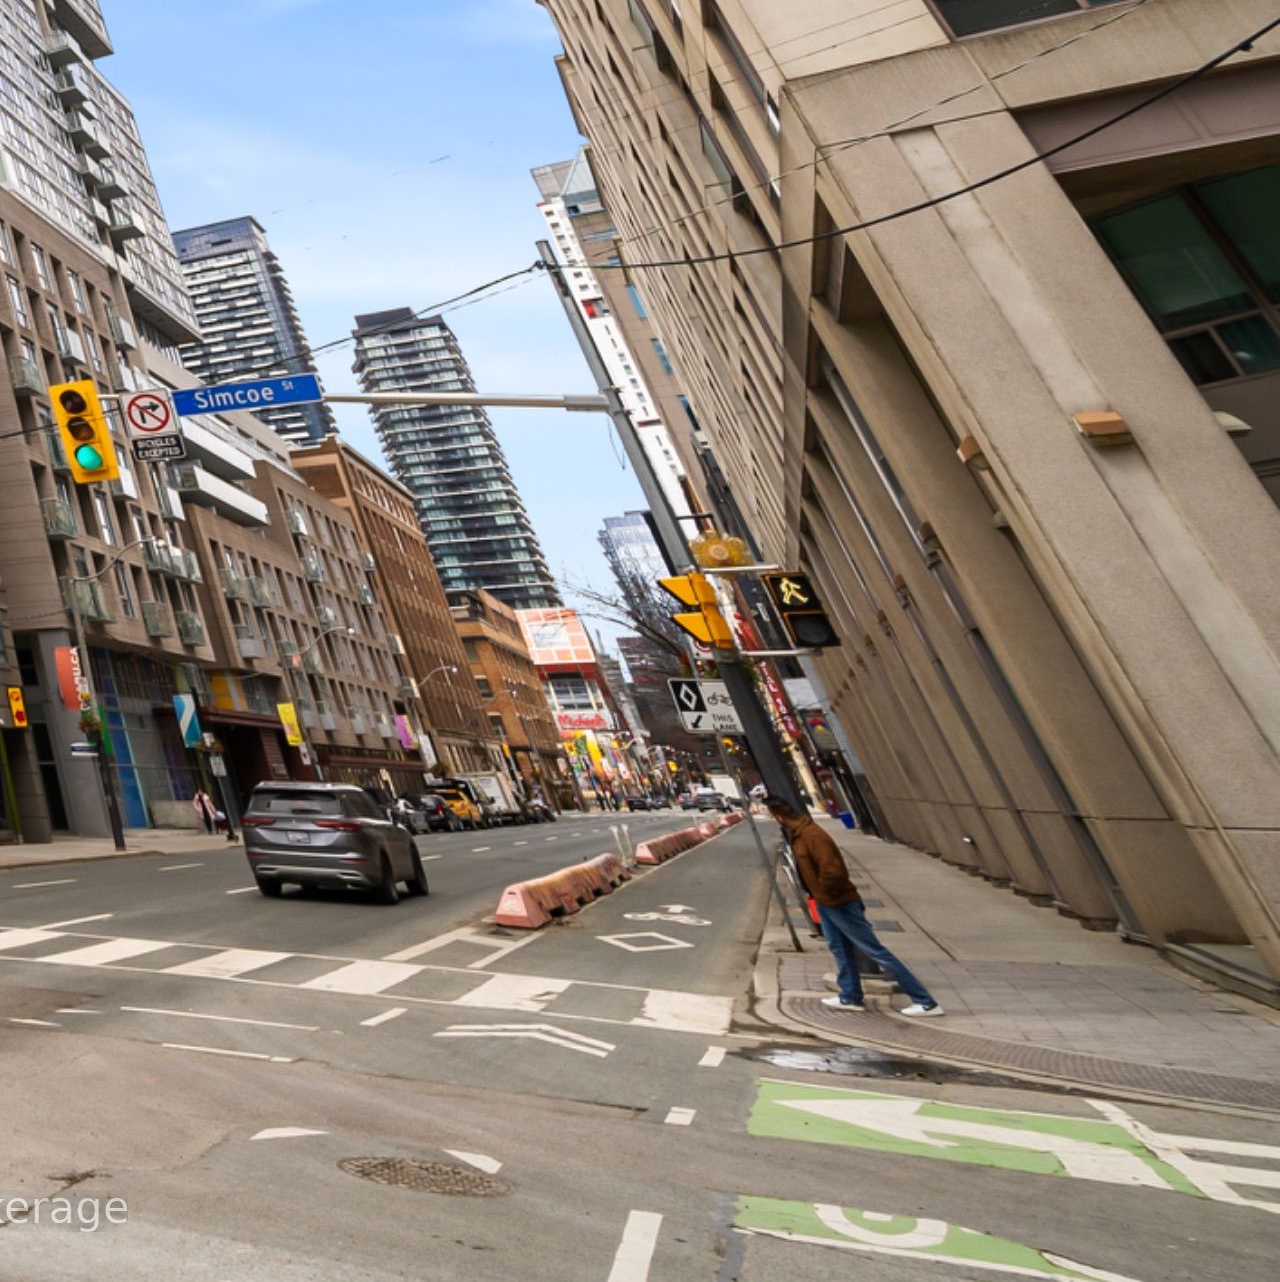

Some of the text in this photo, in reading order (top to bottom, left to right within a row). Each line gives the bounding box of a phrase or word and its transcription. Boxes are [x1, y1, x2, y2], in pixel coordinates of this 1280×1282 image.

[194, 387, 274, 409] Simcoe
[137, 438, 176, 448] BICYCLES
[138, 448, 181, 458] EXCEPTED
[712, 714, 734, 723] THIS
